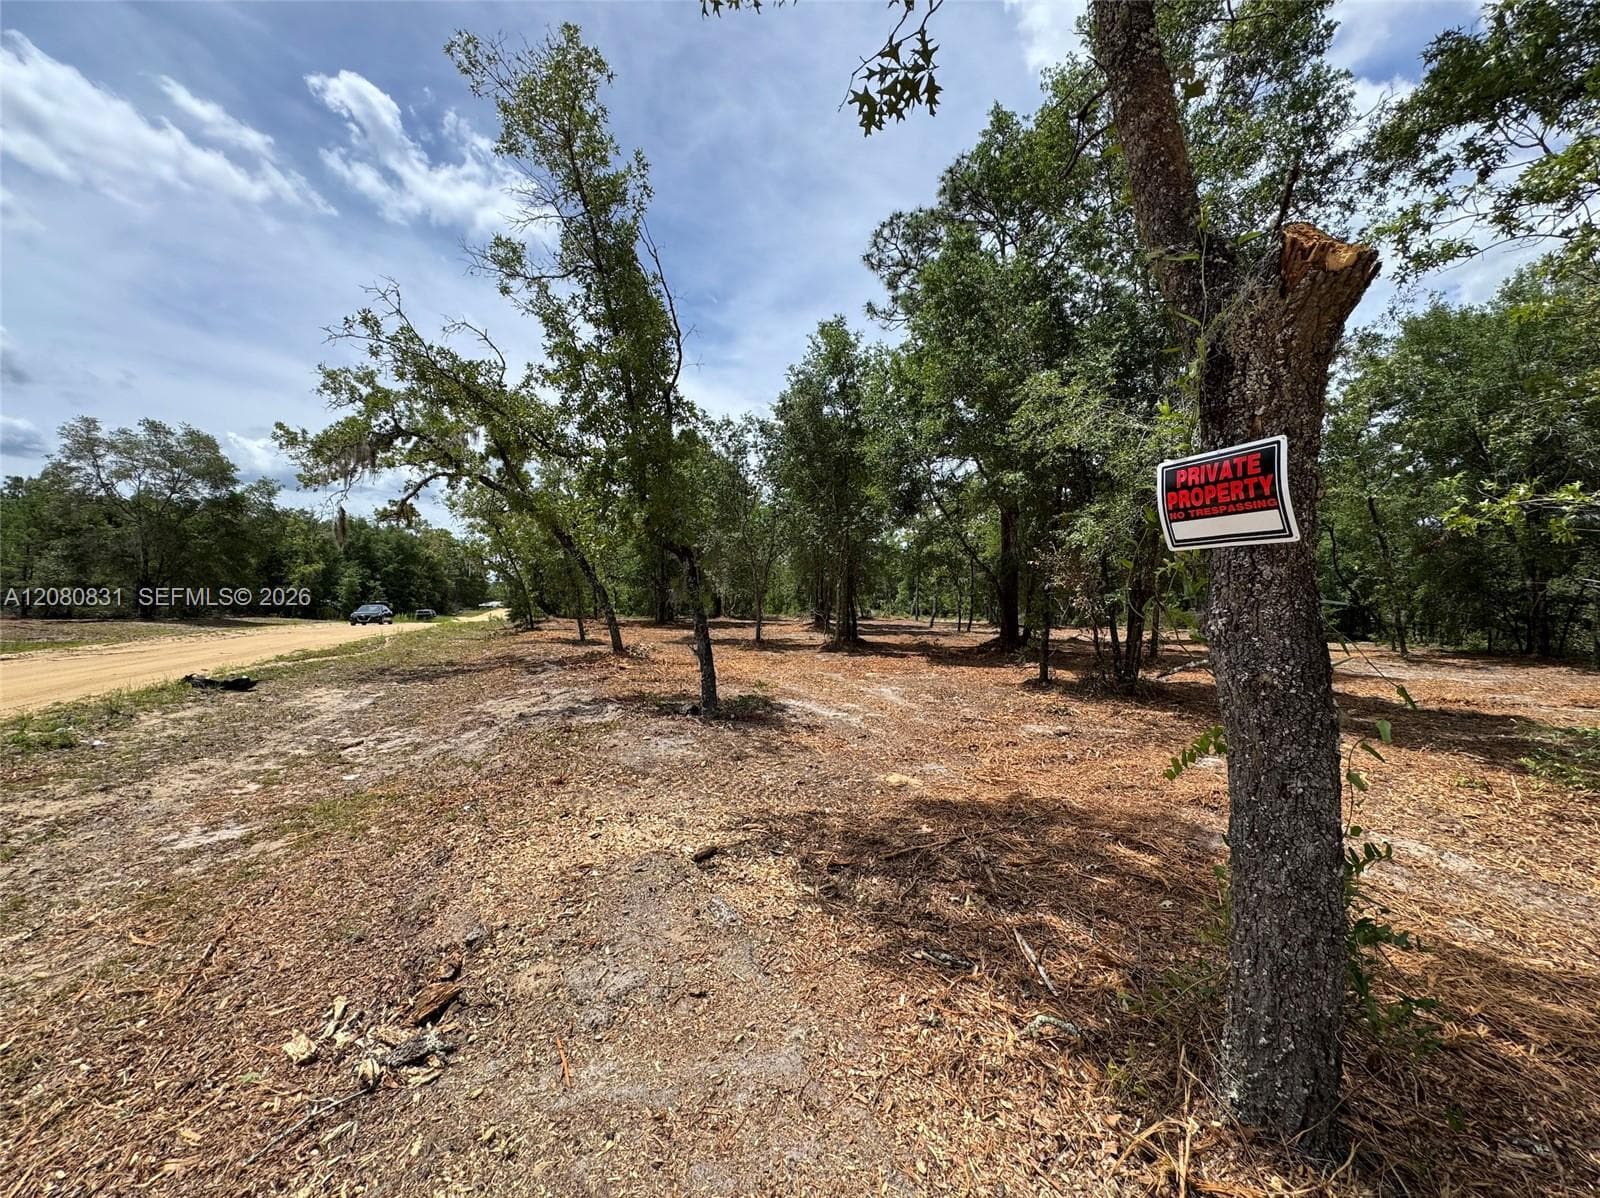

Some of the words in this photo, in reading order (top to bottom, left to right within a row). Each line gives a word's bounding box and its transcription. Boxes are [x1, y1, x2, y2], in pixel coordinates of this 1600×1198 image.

[1176, 452, 1262, 489] PRIVATE
[1167, 473, 1274, 510] PROPERTY
[1169, 510, 1185, 521] NO
[1190, 498, 1278, 518] TRESPASSING
